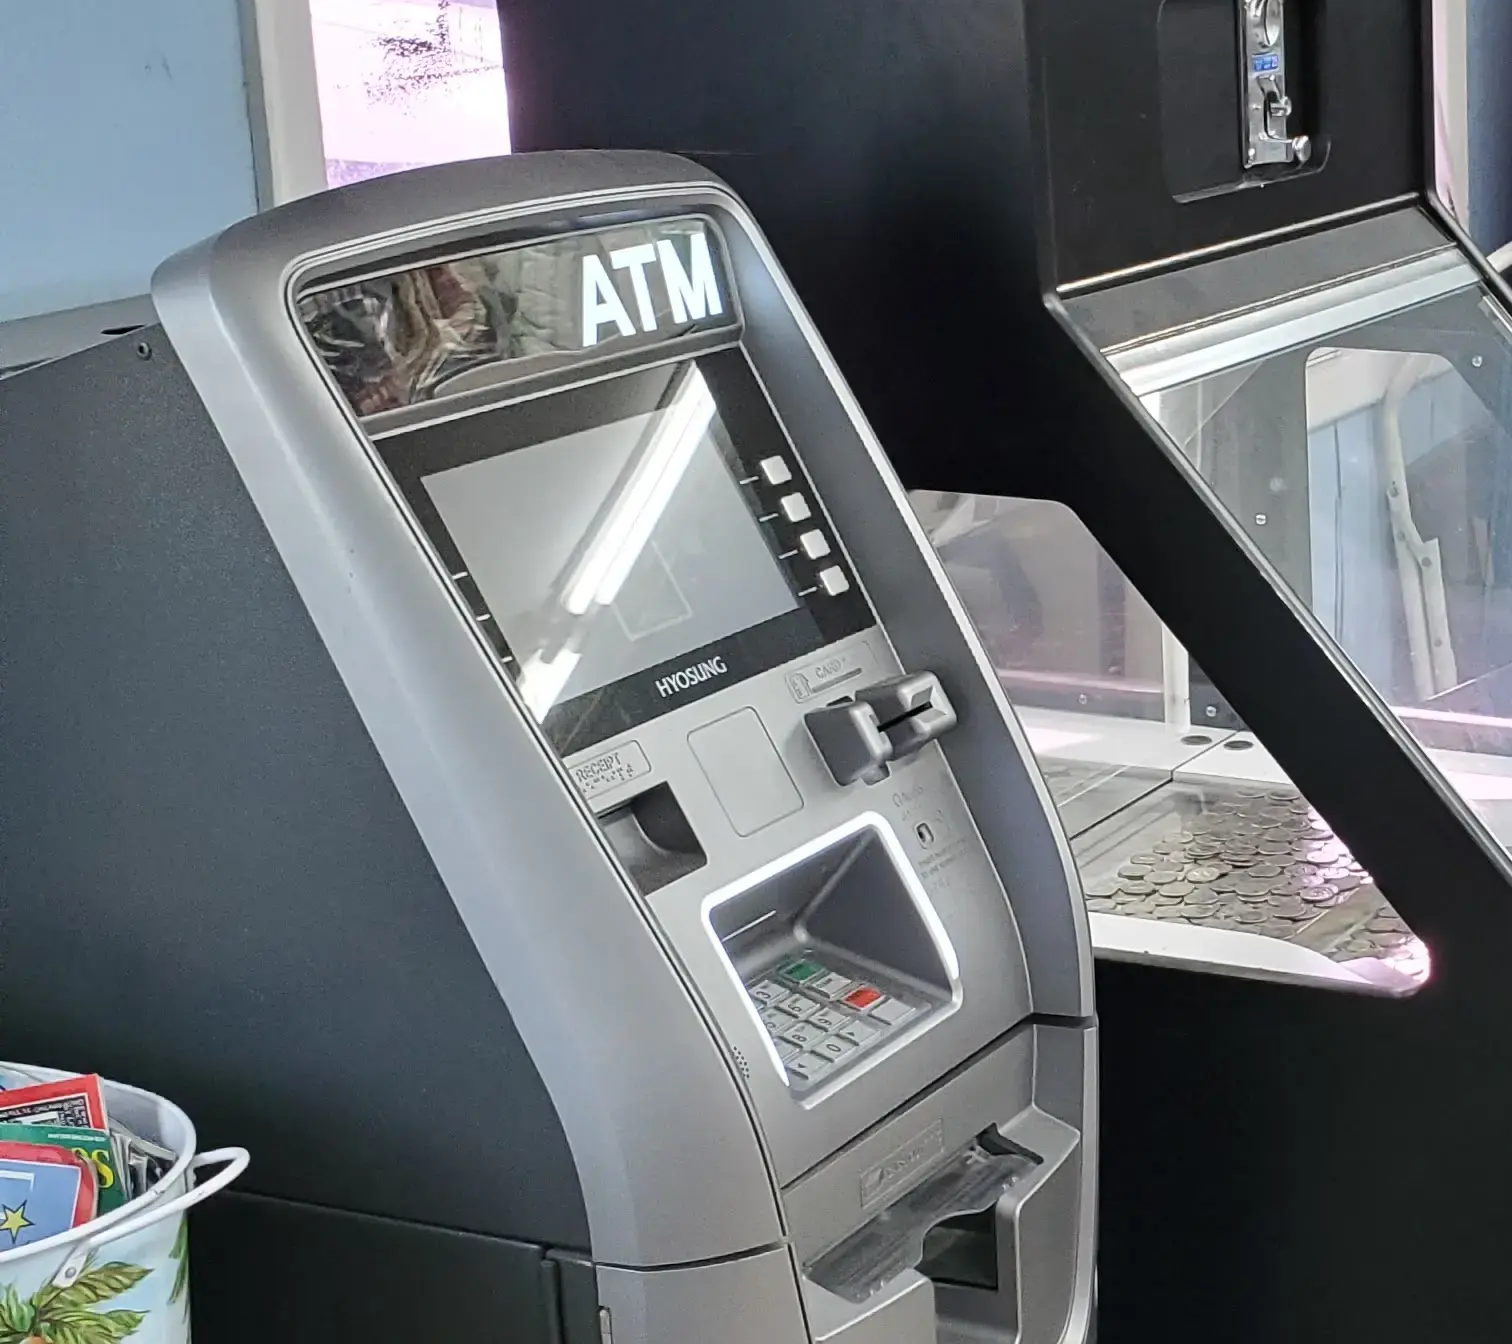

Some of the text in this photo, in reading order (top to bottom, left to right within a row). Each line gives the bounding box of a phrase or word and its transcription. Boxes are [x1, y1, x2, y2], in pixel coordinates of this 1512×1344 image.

[582, 232, 723, 348] ATM
[655, 655, 728, 698] HYOSUNG
[575, 752, 621, 783] RECEIPT
